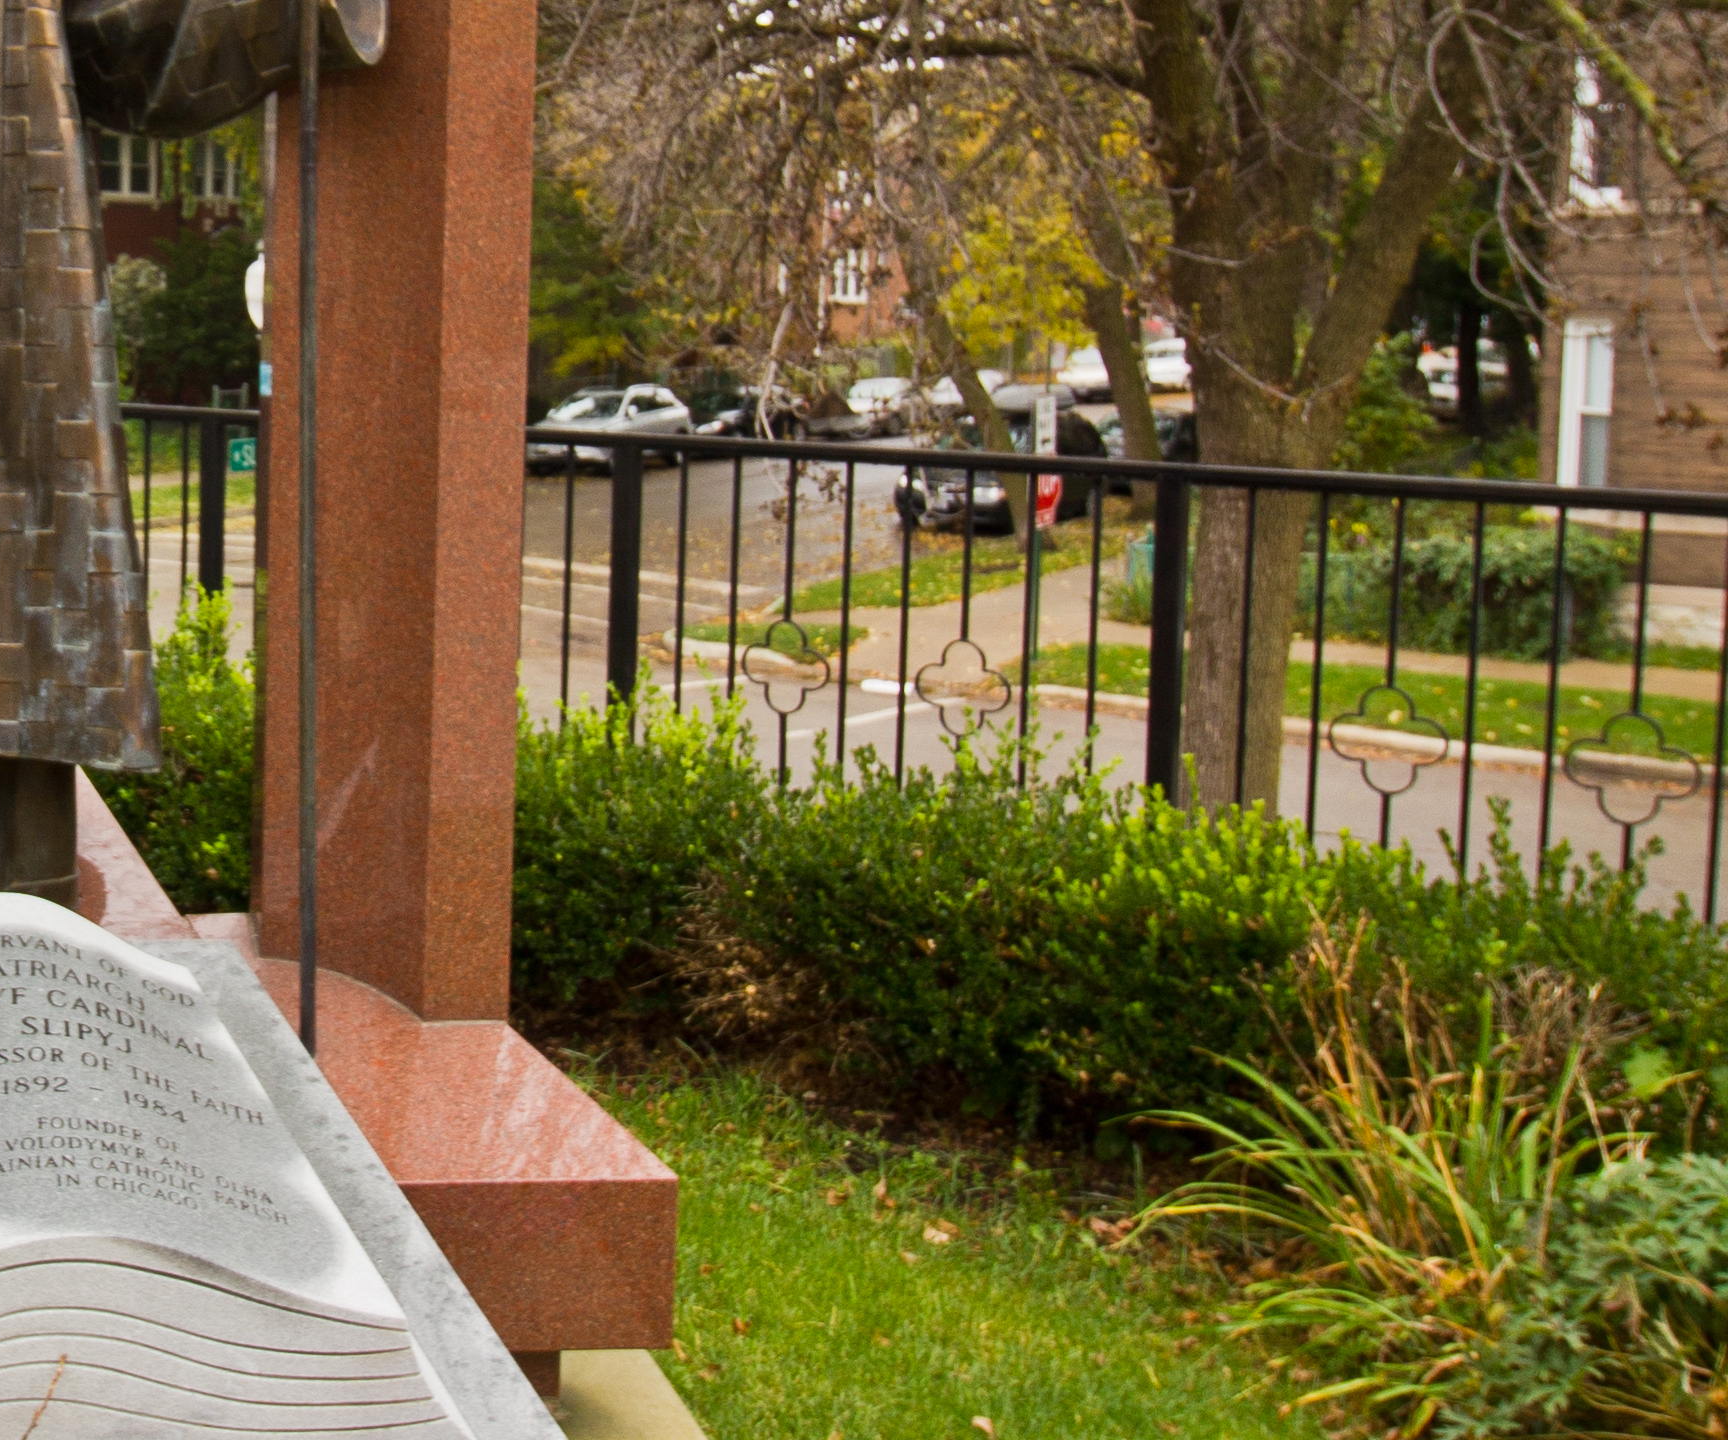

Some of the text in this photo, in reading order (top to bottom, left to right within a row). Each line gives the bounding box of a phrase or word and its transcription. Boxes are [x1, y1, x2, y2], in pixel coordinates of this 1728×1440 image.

[98, 958, 129, 978] OF
[141, 979, 196, 1007] GOD
[20, 1016, 132, 1054] SLIPYJ
[46, 989, 215, 1062] CARDINAL
[2, 1075, 70, 1095] 1892
[123, 1089, 188, 1123] 1984
[80, 1051, 114, 1071] OF
[126, 1064, 178, 1095] THE
[190, 1089, 265, 1126] FAITH
[37, 1116, 182, 1153] FOUNDER OF
[4, 1135, 148, 1160] VOLODYMYR
[159, 1157, 205, 1179] AND
[215, 1174, 274, 1205] OLHA
[56, 1173, 199, 1210] IN CHICAGO
[90, 1156, 202, 1195] CATHOLIC
[213, 1190, 289, 1225] PARISH
